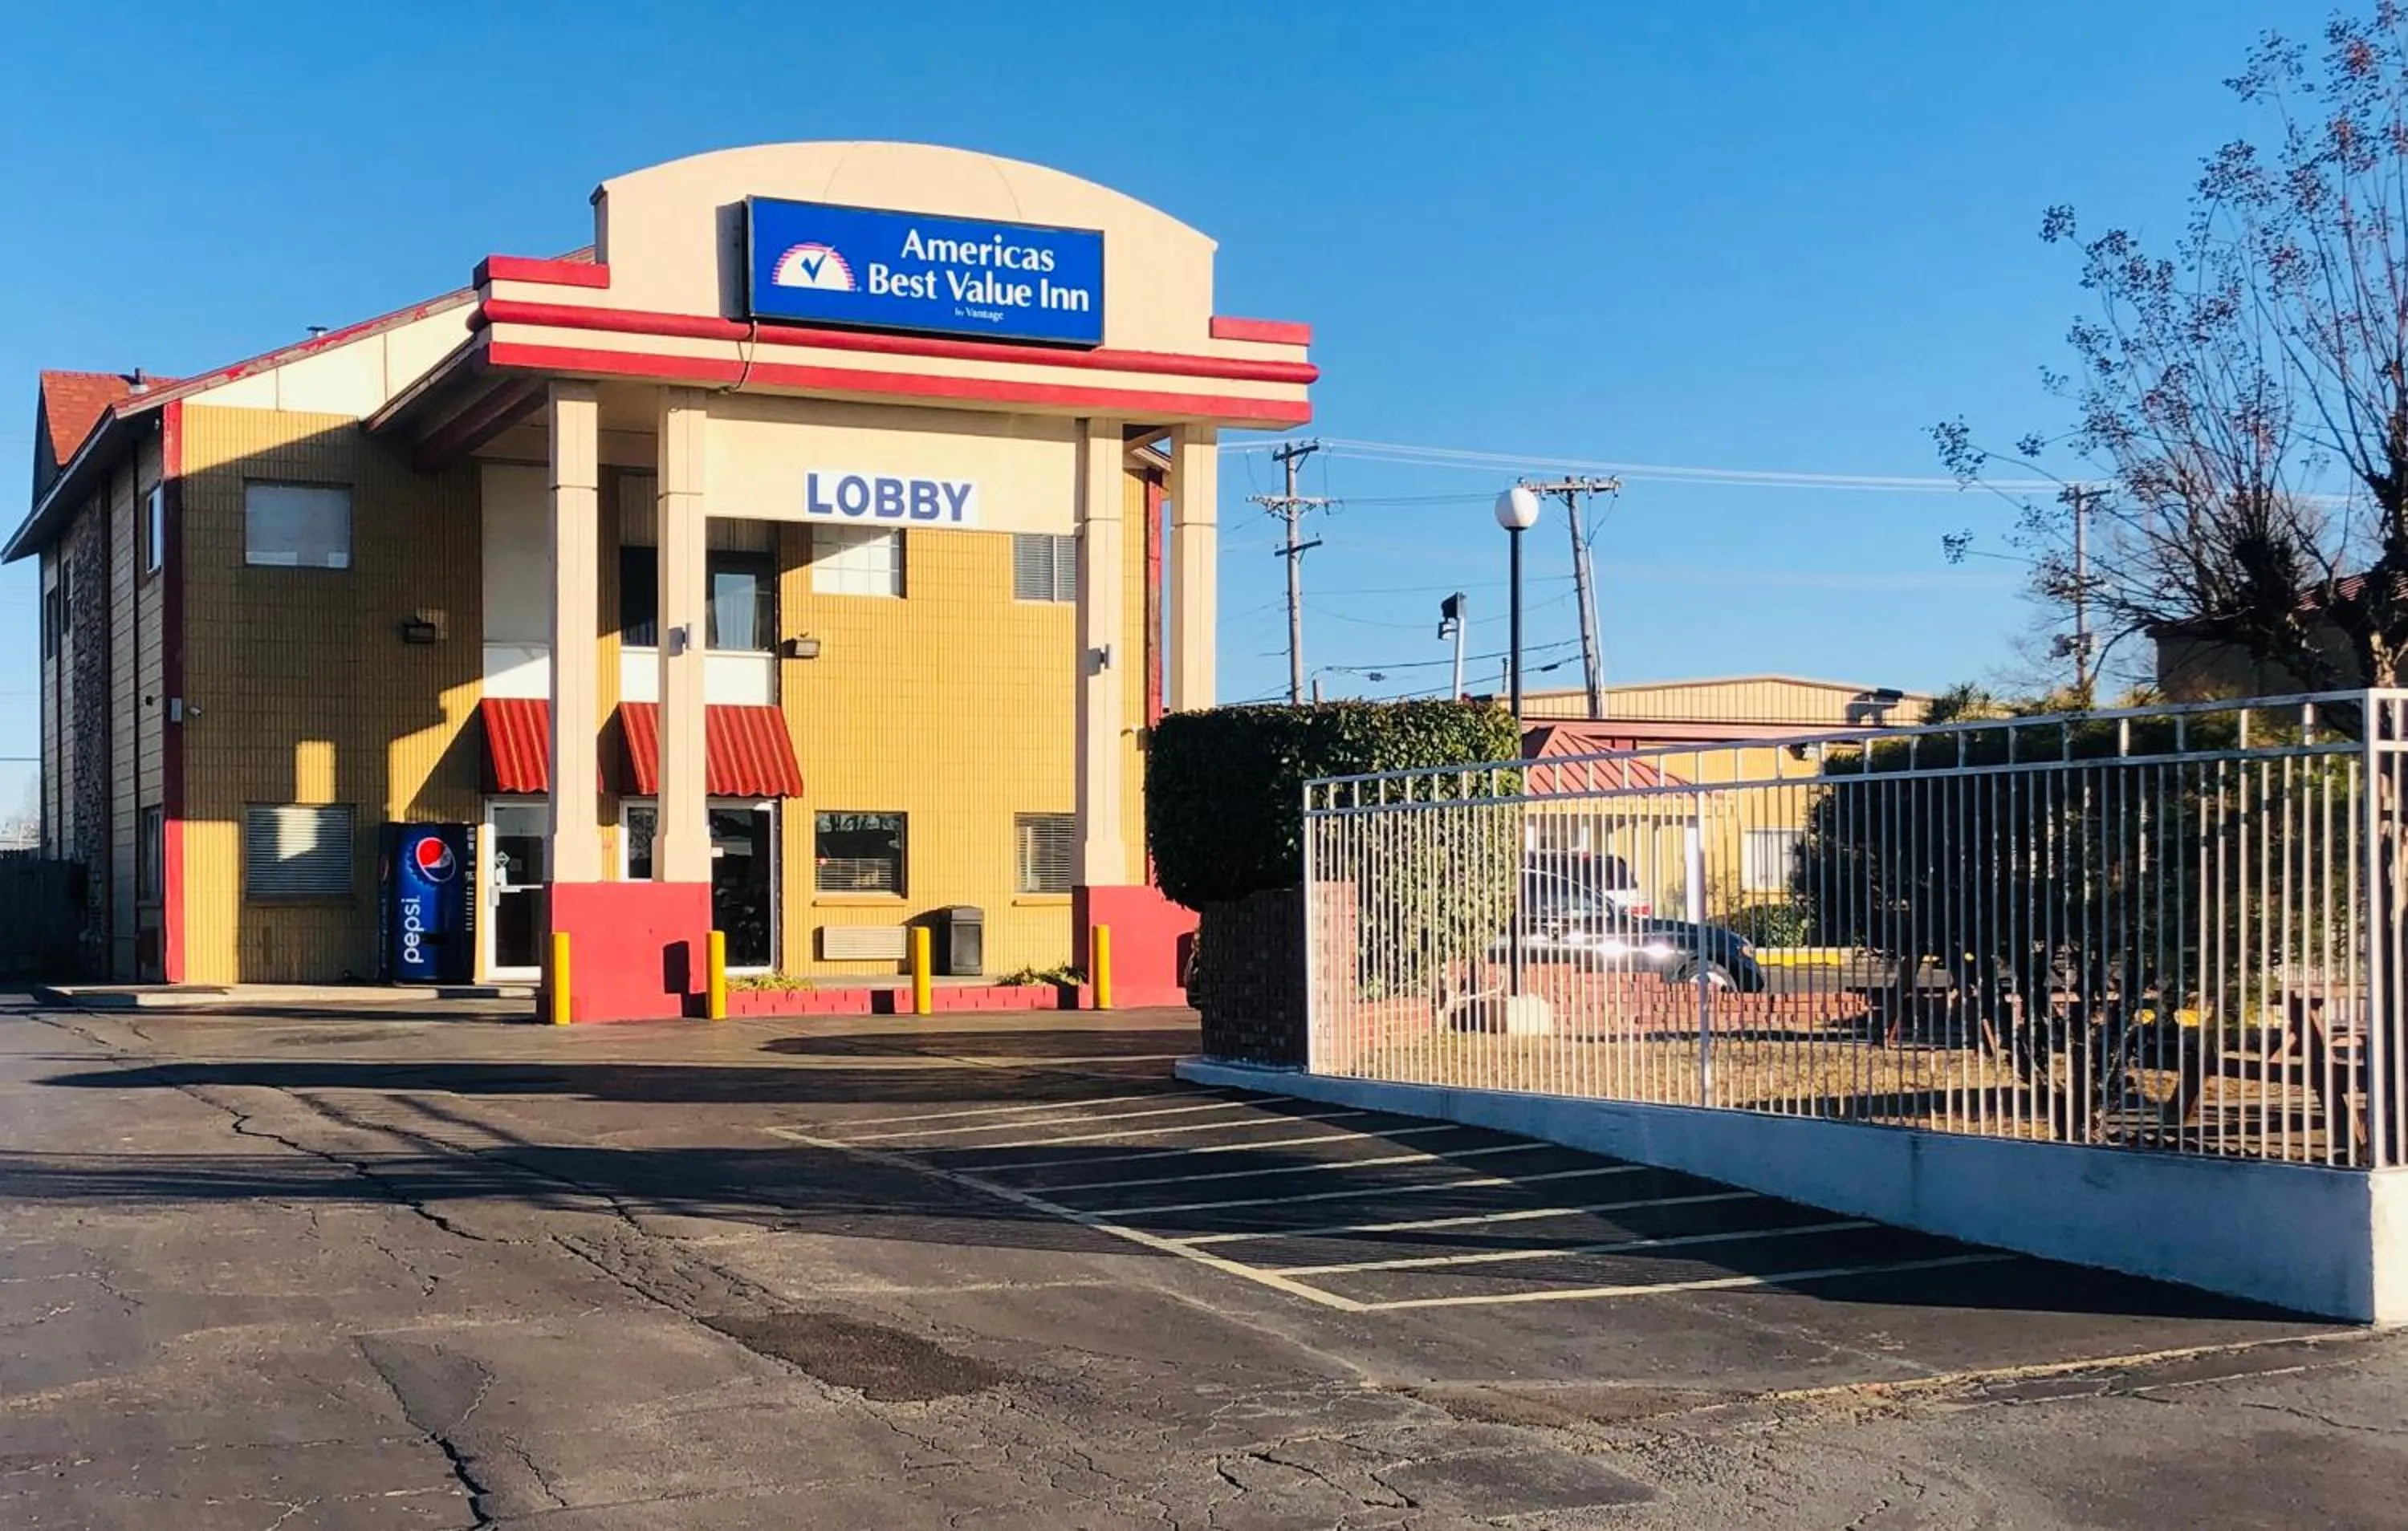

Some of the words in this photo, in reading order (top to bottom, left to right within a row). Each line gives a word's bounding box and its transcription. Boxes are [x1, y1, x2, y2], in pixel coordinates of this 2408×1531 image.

[901, 229, 1055, 272] Americas
[868, 263, 938, 300] Best
[946, 270, 1032, 307] Value
[1040, 278, 1089, 312] Inn
[966, 307, 1004, 322] Vantage
[807, 473, 973, 522] LOBBY
[401, 897, 425, 964] pepsi
